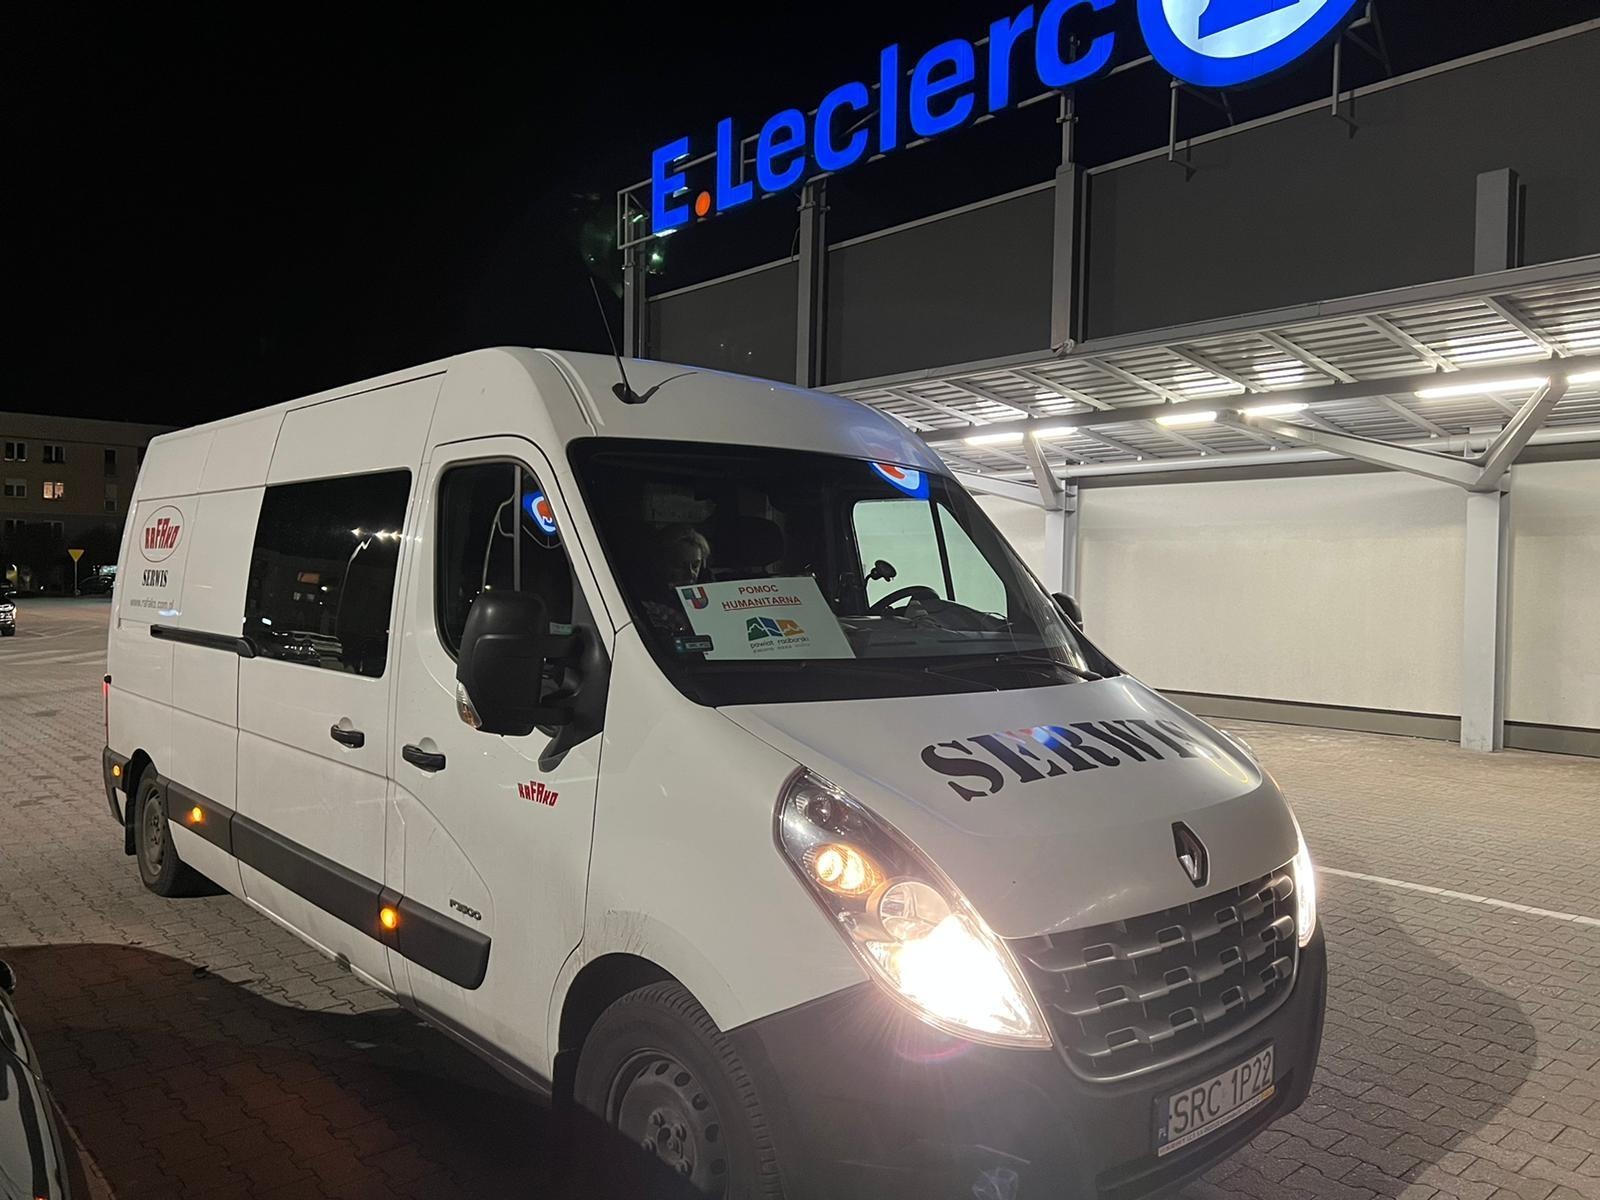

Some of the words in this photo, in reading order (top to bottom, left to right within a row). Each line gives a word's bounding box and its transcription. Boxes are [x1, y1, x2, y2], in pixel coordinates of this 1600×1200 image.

[650, 0, 1117, 235] E.Leclerc
[145, 518, 180, 549] RAFAKO
[142, 569, 168, 587] SERWIS
[738, 584, 779, 595] POMOC
[721, 595, 801, 610] HUMANITARNA
[750, 640, 775, 650] powiat
[920, 719, 1216, 801] SERWIS
[517, 780, 559, 807] RAFAKO
[1173, 1079, 1222, 1134] SRC
[1231, 1051, 1272, 1105] 1P22
